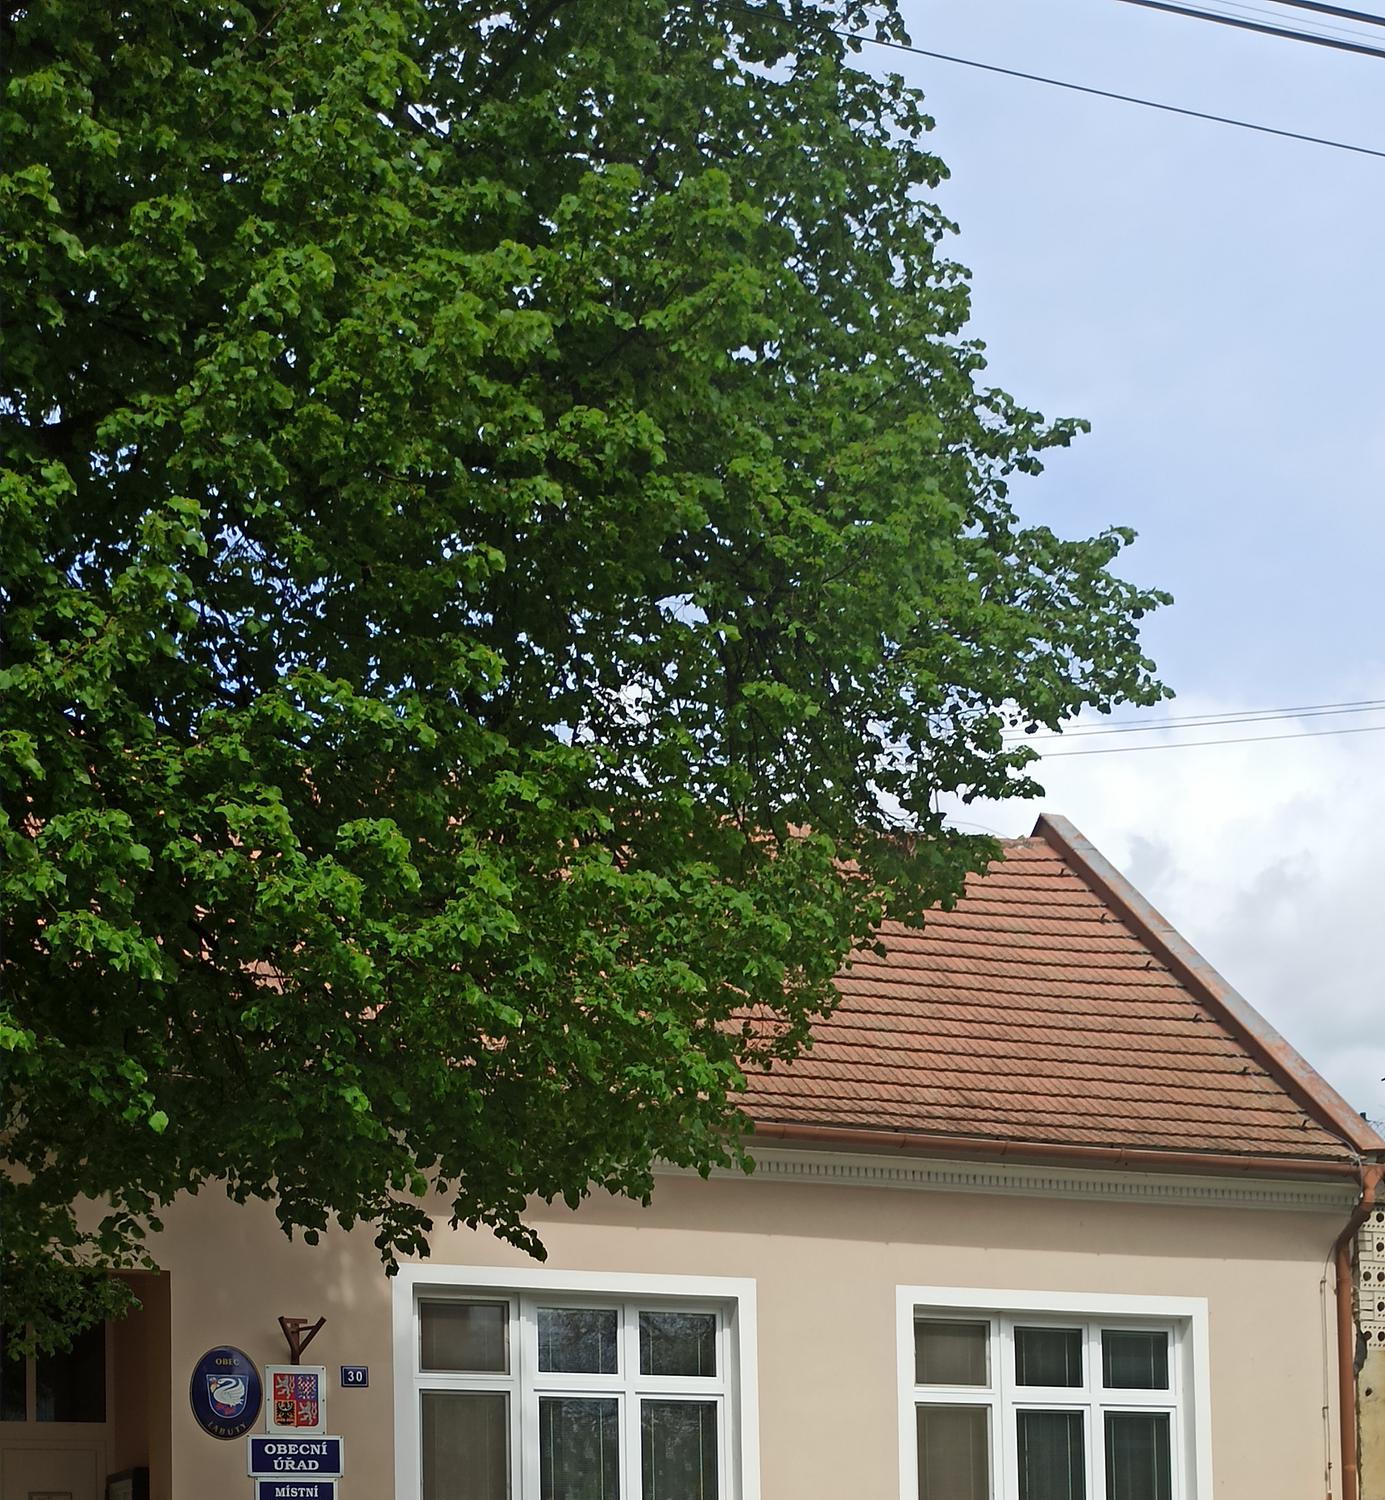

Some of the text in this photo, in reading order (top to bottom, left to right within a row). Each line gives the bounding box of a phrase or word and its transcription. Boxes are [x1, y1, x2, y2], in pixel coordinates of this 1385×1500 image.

[215, 1358, 240, 1366] OBEC
[347, 1371, 363, 1382] 30
[264, 1442, 328, 1455] OBECNÍ
[273, 1457, 319, 1471] ÚŘAD
[275, 1485, 319, 1497] MÍSTNÍ
